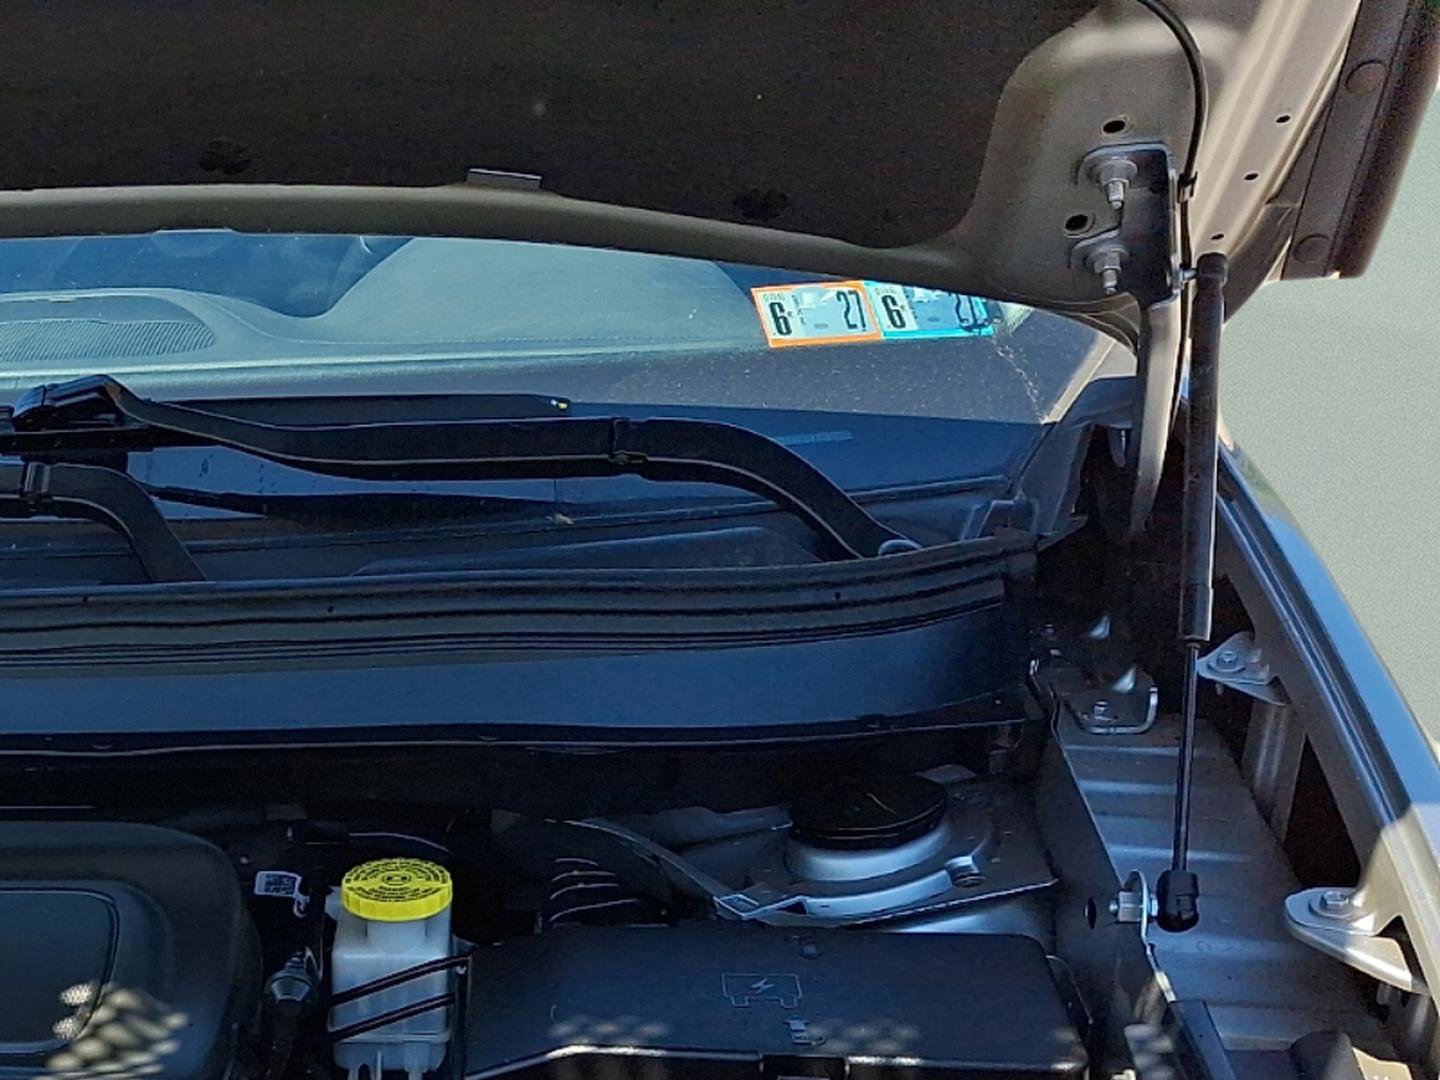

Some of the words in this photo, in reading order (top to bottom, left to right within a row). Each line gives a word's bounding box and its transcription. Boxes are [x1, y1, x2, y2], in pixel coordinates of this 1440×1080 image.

[769, 302, 792, 335] 6
[836, 290, 866, 329] 27
[881, 295, 906, 328] 6
